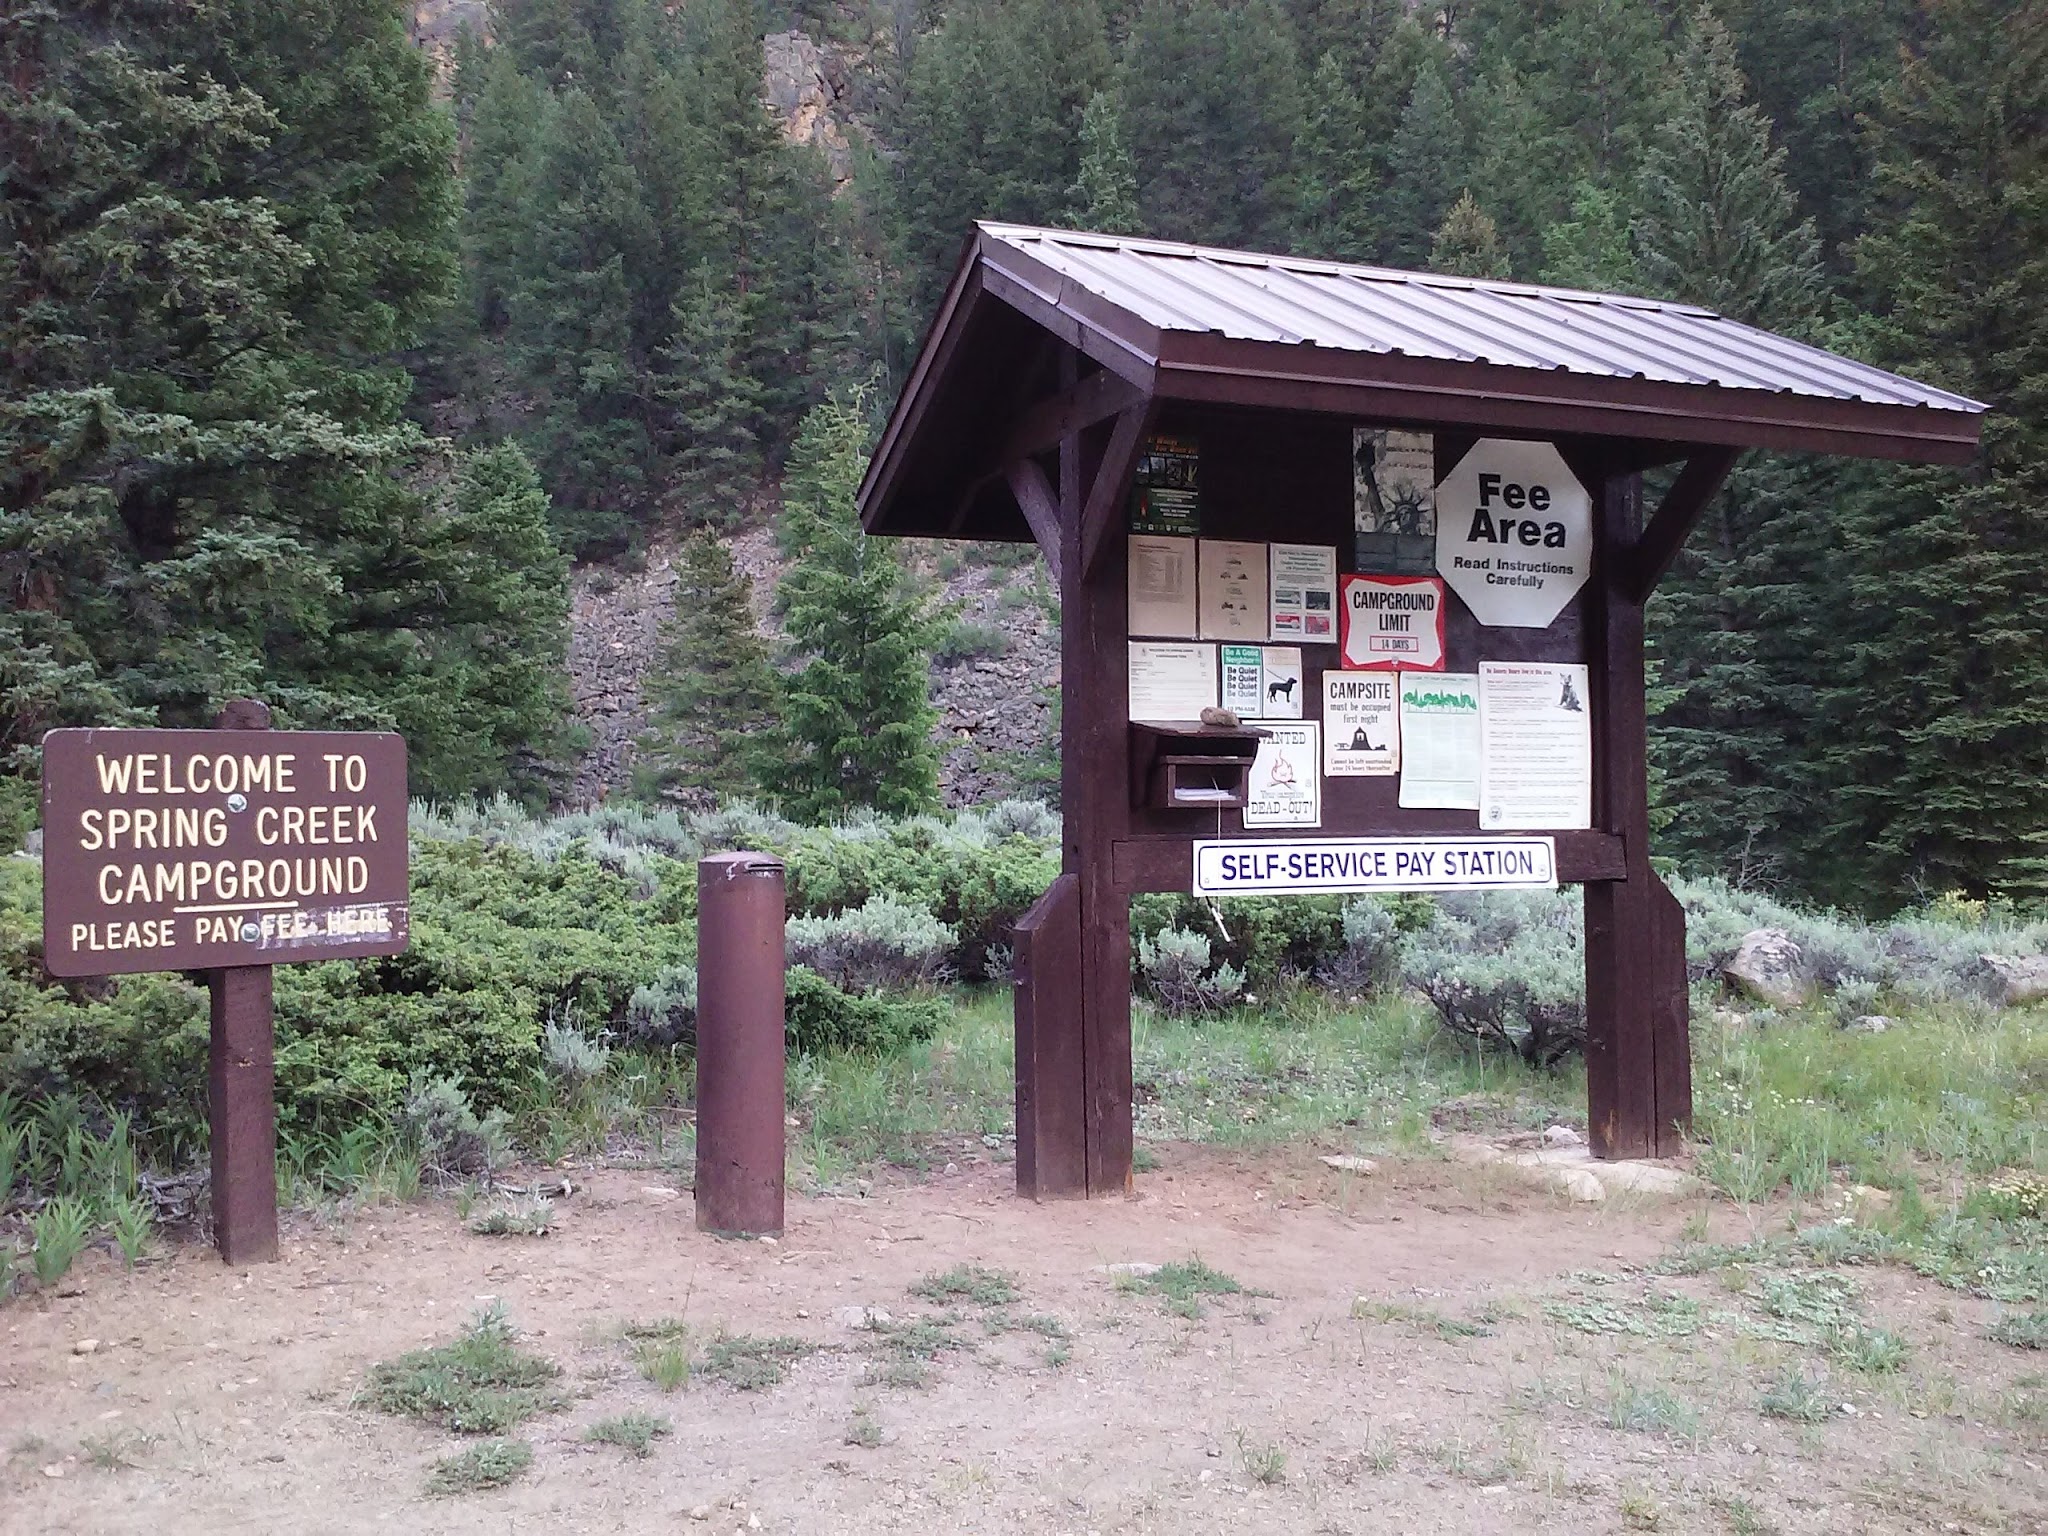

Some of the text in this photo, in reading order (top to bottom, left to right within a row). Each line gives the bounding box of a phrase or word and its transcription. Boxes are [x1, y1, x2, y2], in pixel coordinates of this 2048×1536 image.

[1479, 473, 1551, 511] Fee
[1467, 509, 1566, 548] Area
[1454, 557, 1574, 575] Read Instructions
[1486, 573, 1544, 589] Carefully
[1354, 591, 1434, 611] CAMPGROUND
[1379, 614, 1411, 632] LIMIT
[1382, 640, 1410, 650] 14 DAYS
[1330, 682, 1391, 699] CAMPSITE
[1330, 702, 1391, 713] must be occupied
[1343, 714, 1378, 725] first night
[96, 754, 367, 794] WELCOME TO
[80, 806, 378, 851] SPRING CREEK
[1221, 850, 1533, 881] SELF-SERVICE PAY STATION
[100, 856, 368, 905] CAMPGROUND
[72, 908, 390, 952] PLEASE PAY FEE HERE
